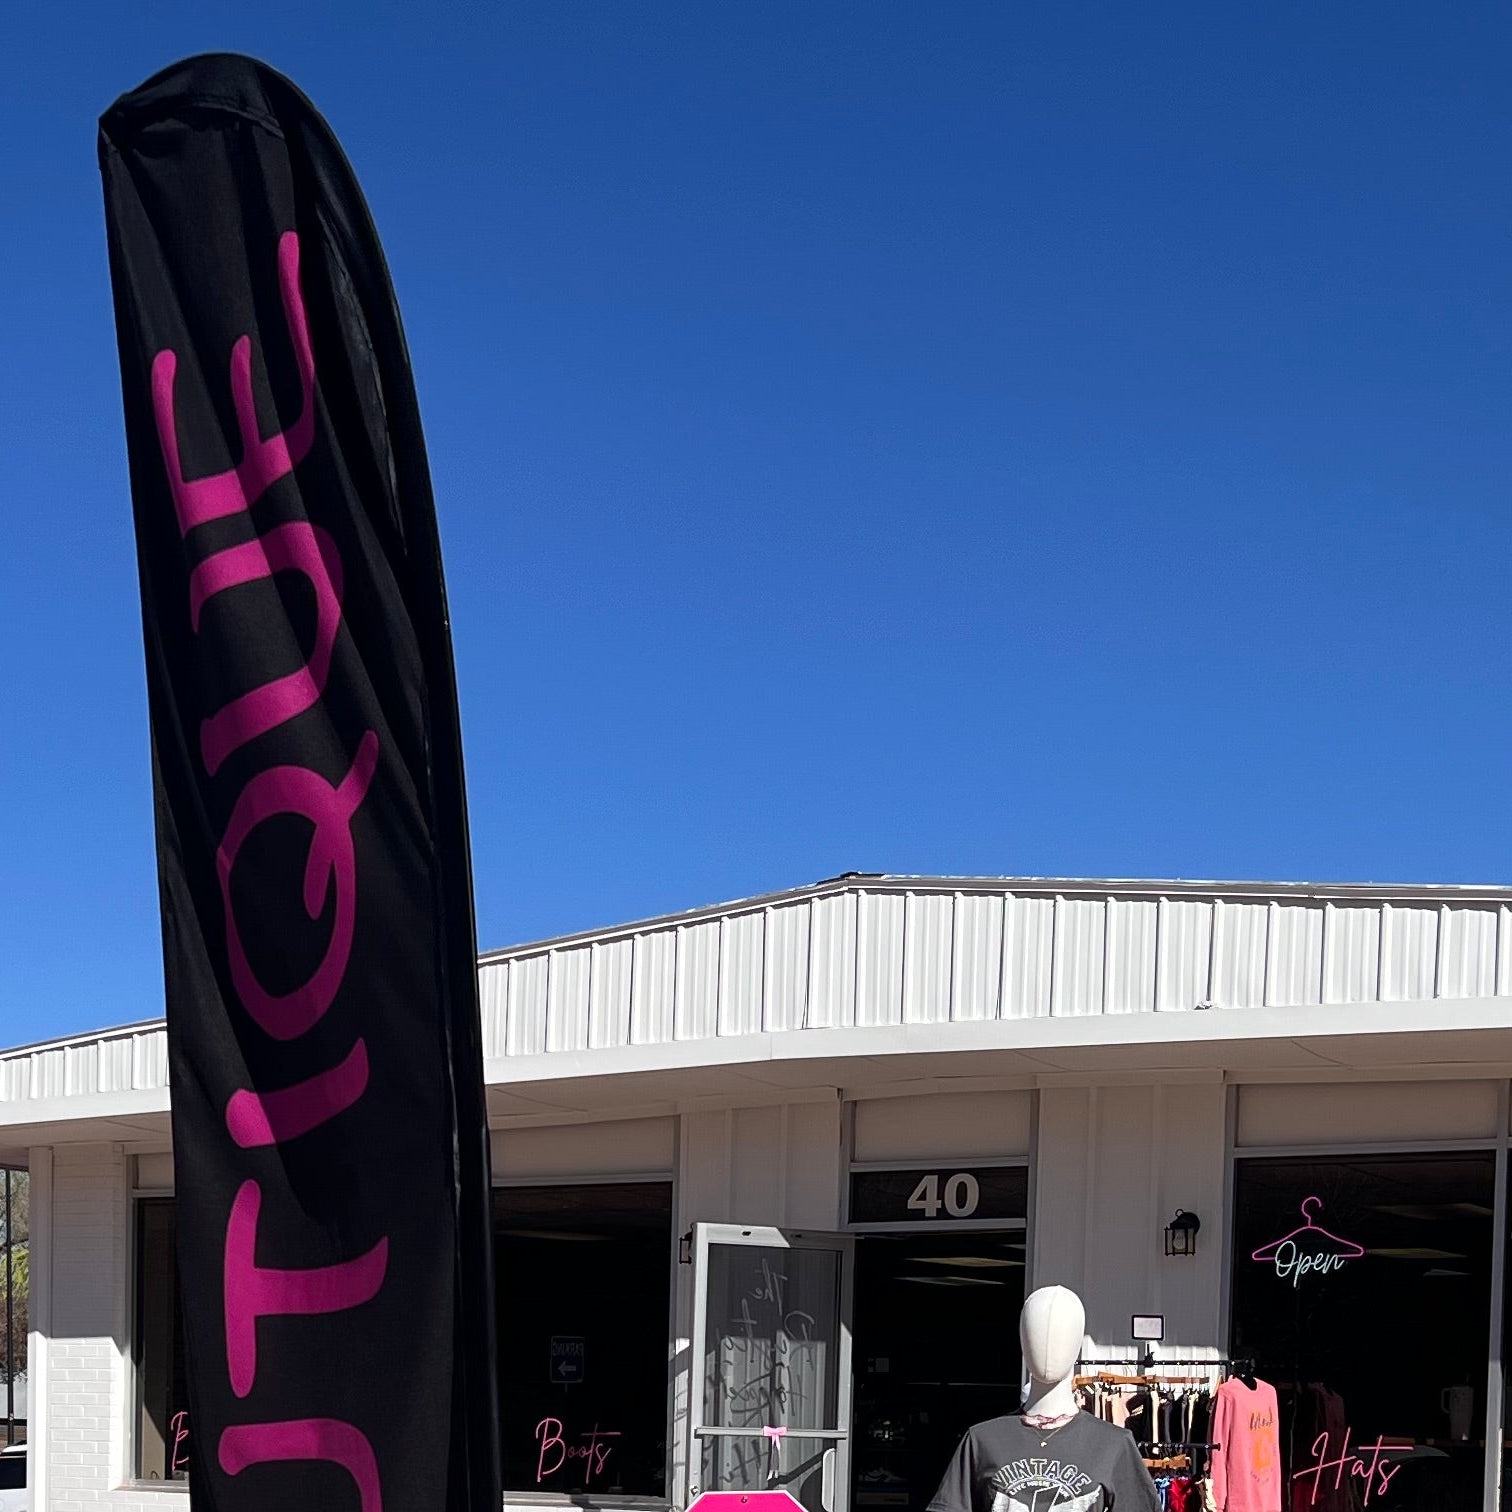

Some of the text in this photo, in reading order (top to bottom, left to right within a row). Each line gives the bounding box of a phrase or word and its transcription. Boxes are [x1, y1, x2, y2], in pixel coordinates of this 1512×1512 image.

[907, 1173, 979, 1217] 40
[1275, 1240, 1345, 1287] Open
[535, 1417, 621, 1485] Boots
[1292, 1426, 1414, 1507] Hats
[991, 1458, 1092, 1495] VINTAGE
